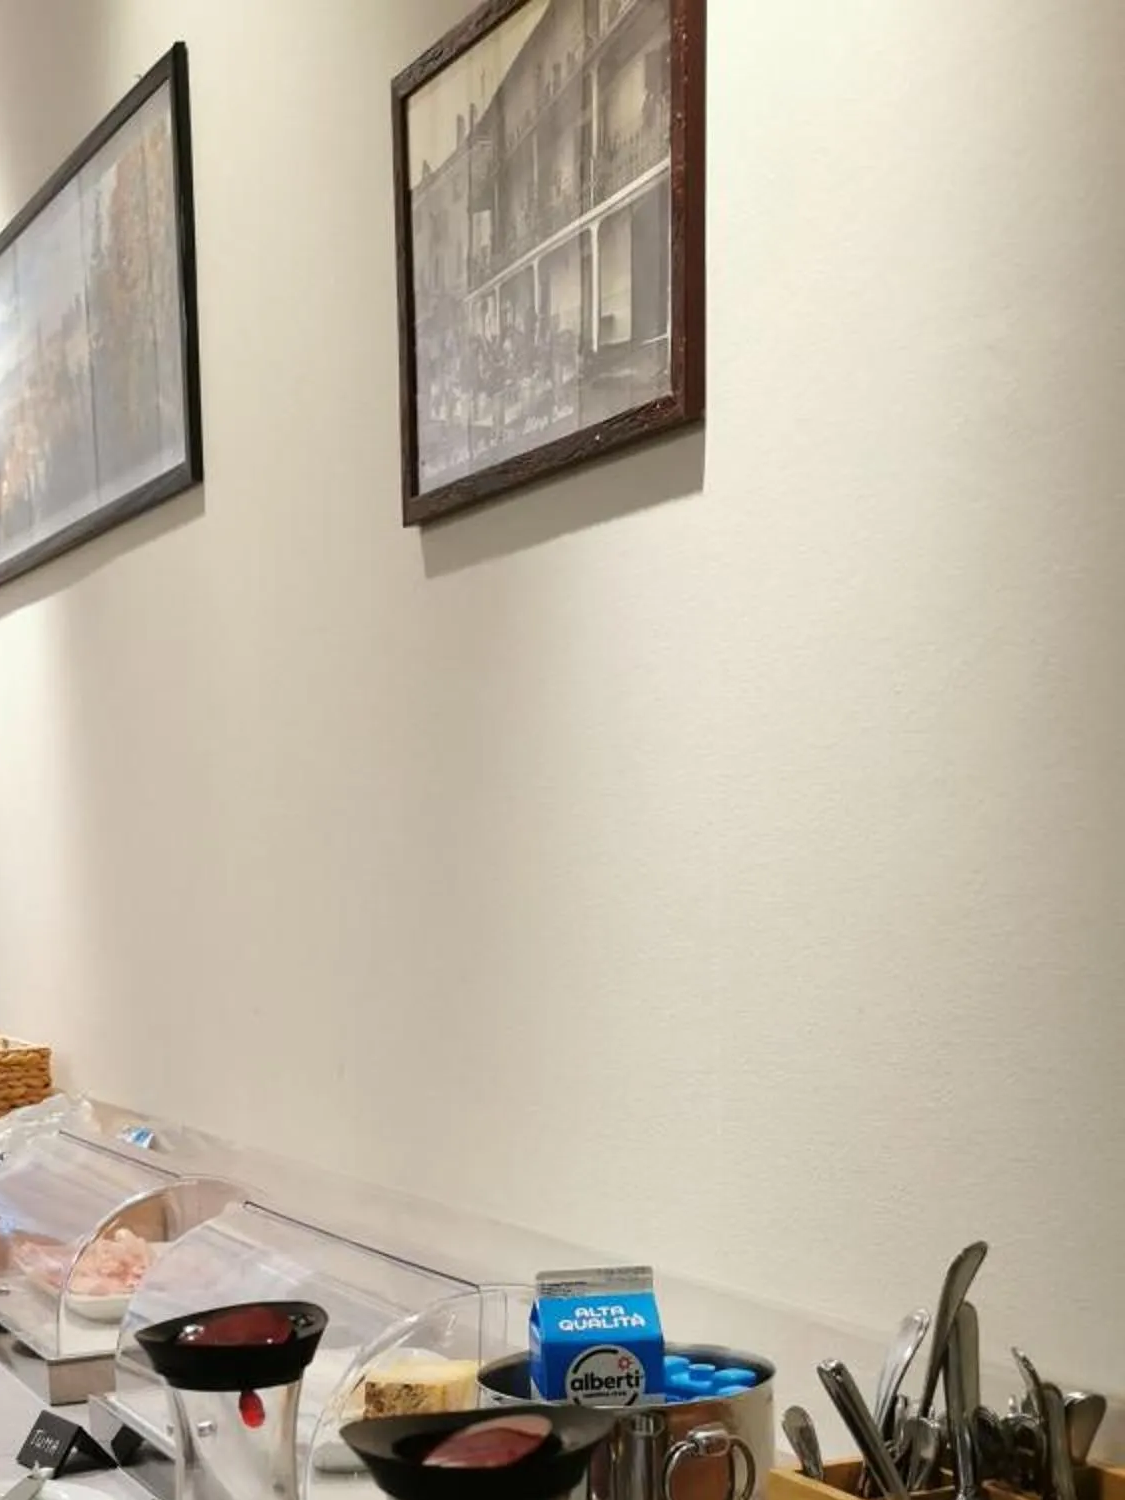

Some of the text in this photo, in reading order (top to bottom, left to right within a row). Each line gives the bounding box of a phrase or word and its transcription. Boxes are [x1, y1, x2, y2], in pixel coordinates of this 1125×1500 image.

[575, 1304, 625, 1318] ALTA
[558, 1312, 647, 1332] QUALITÀ
[570, 1370, 640, 1391] alberti
